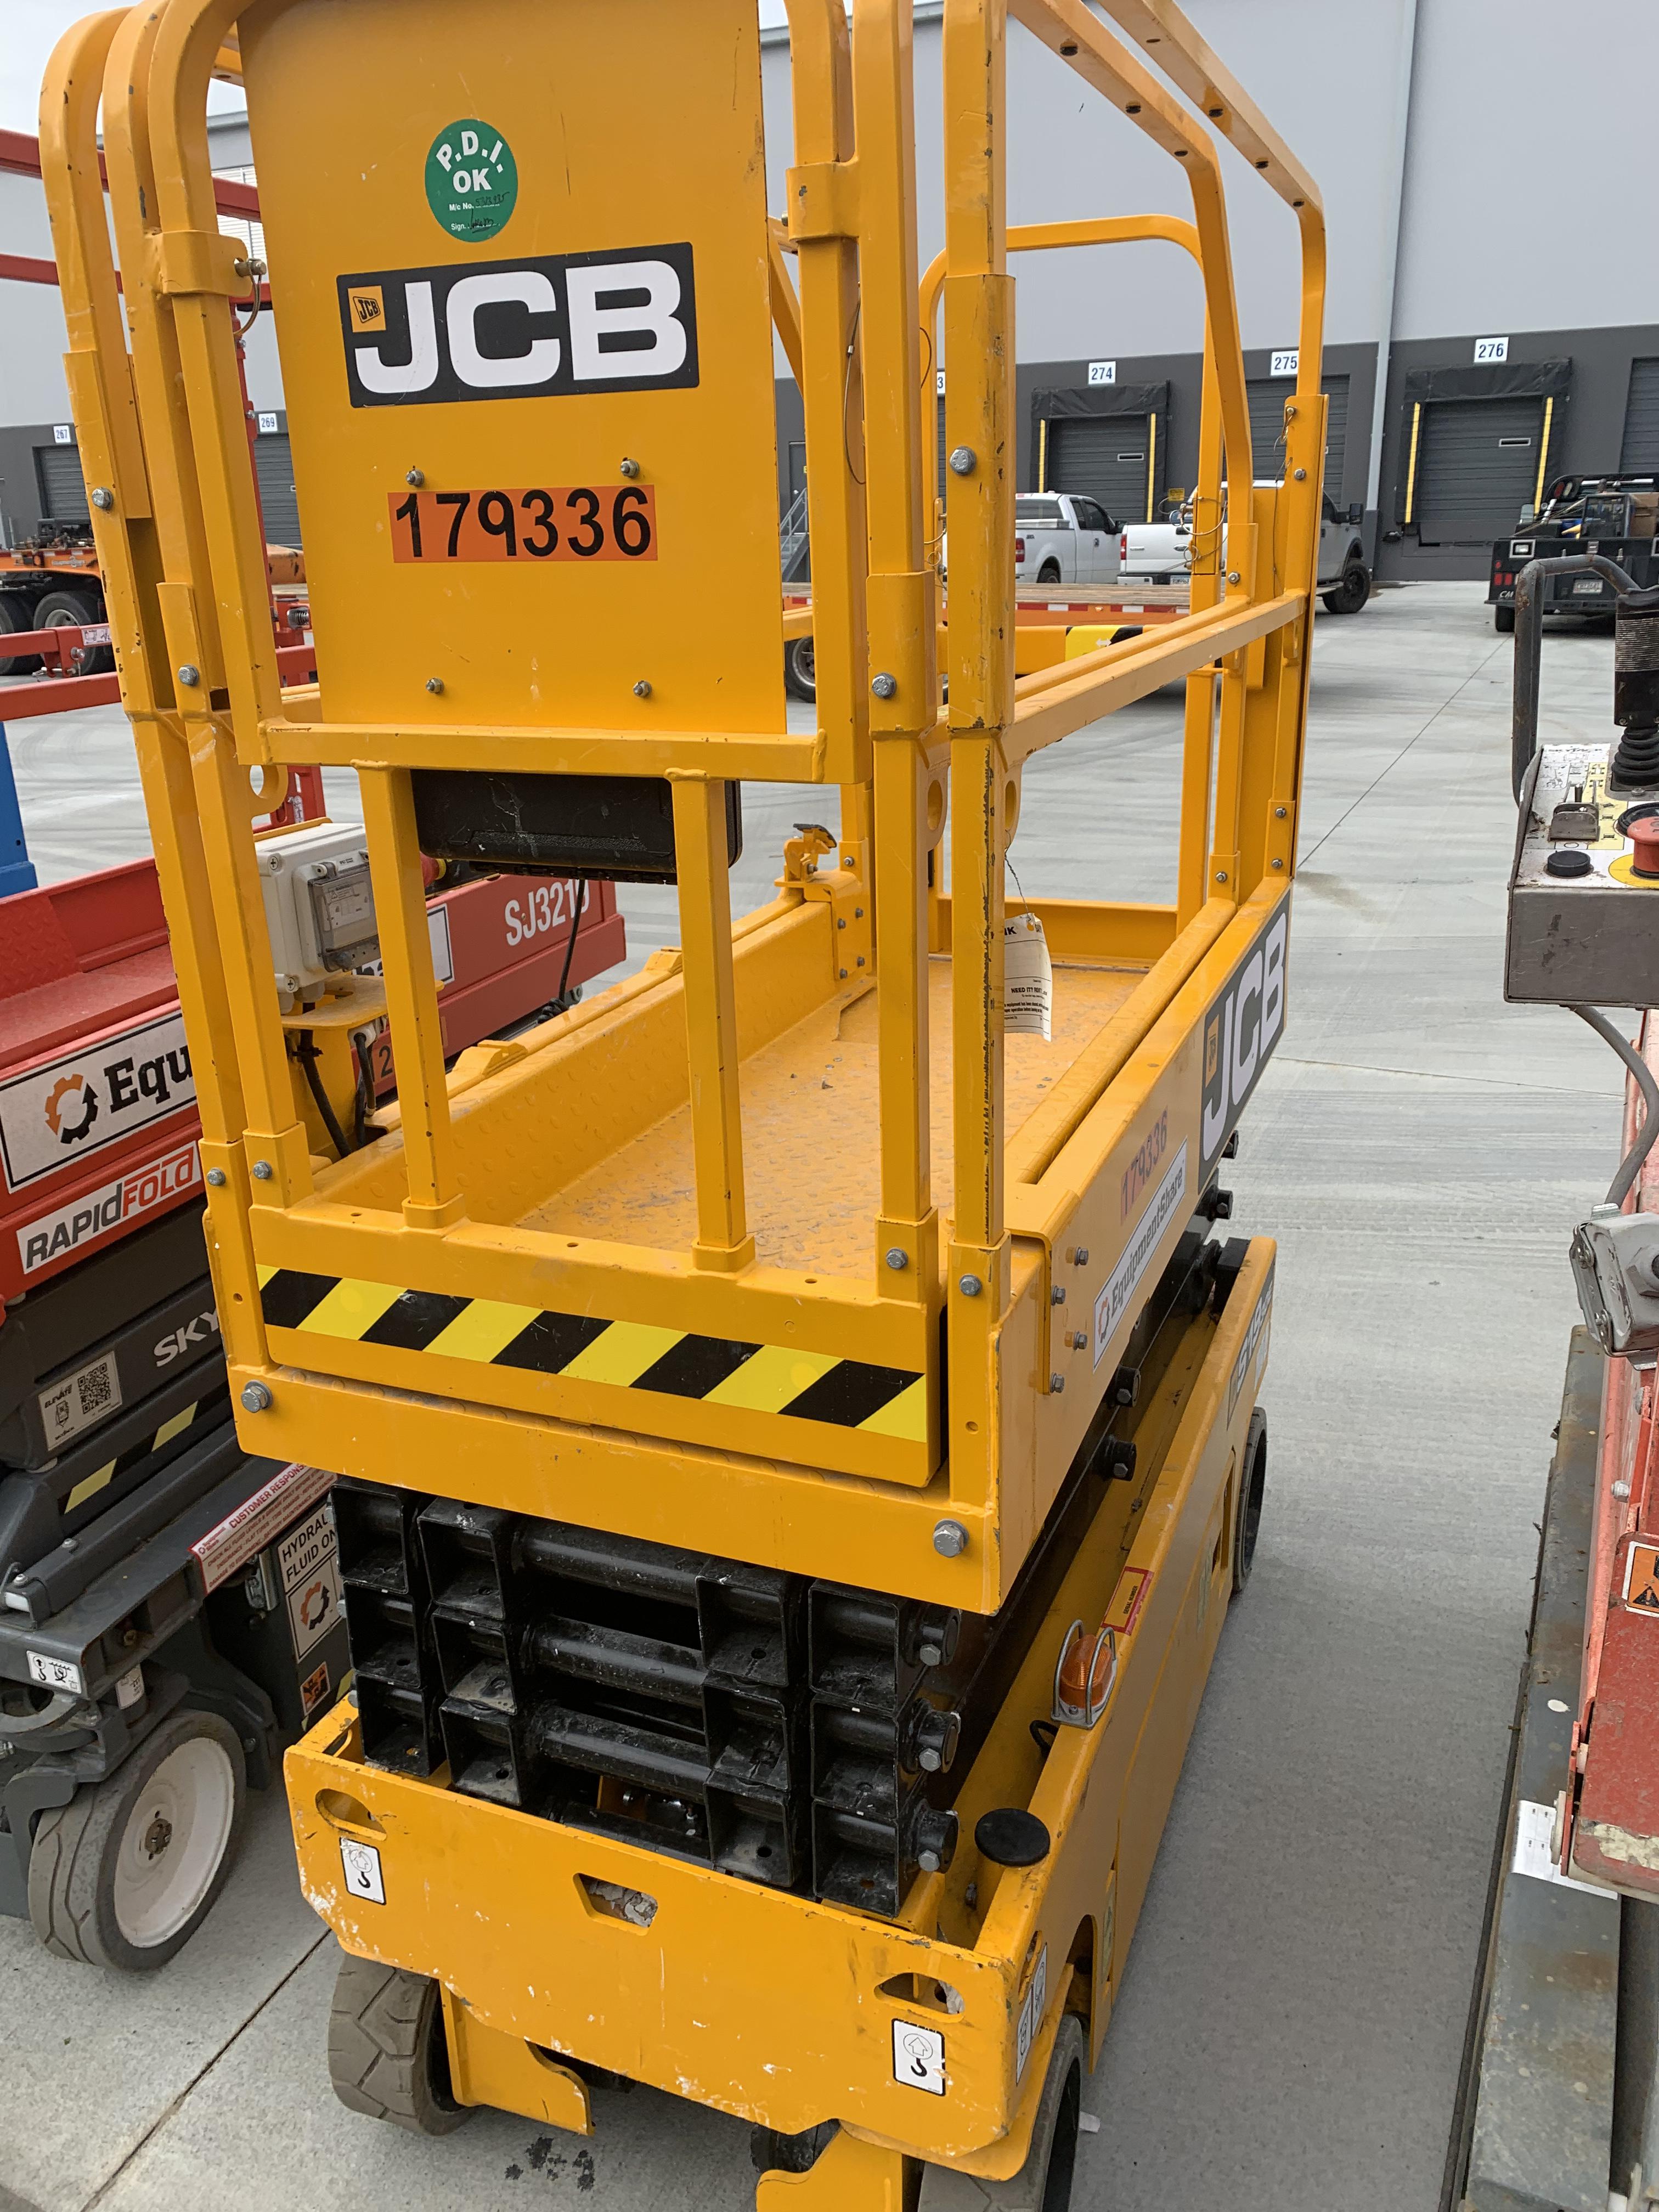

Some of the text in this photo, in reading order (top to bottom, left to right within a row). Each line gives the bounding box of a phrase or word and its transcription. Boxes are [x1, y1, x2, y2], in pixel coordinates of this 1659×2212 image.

[436, 131, 504, 173] P.D.I.
[453, 167, 492, 193] OK
[354, 260, 687, 394] JCB
[358, 299, 379, 320] JCB
[1274, 356, 1297, 370] 275
[1479, 343, 1504, 358] 276
[1092, 366, 1112, 380] 274
[261, 417, 275, 427] 269
[395, 486, 652, 558] 179336
[1203, 912, 1286, 1161] JCB
[1122, 1110, 1167, 1215] 179336
[1111, 1166, 1183, 1318] EquipmentShare
[229, 1463, 304, 1528] CUSTOMER RESPONS
[286, 1544, 319, 1583] FLUID
